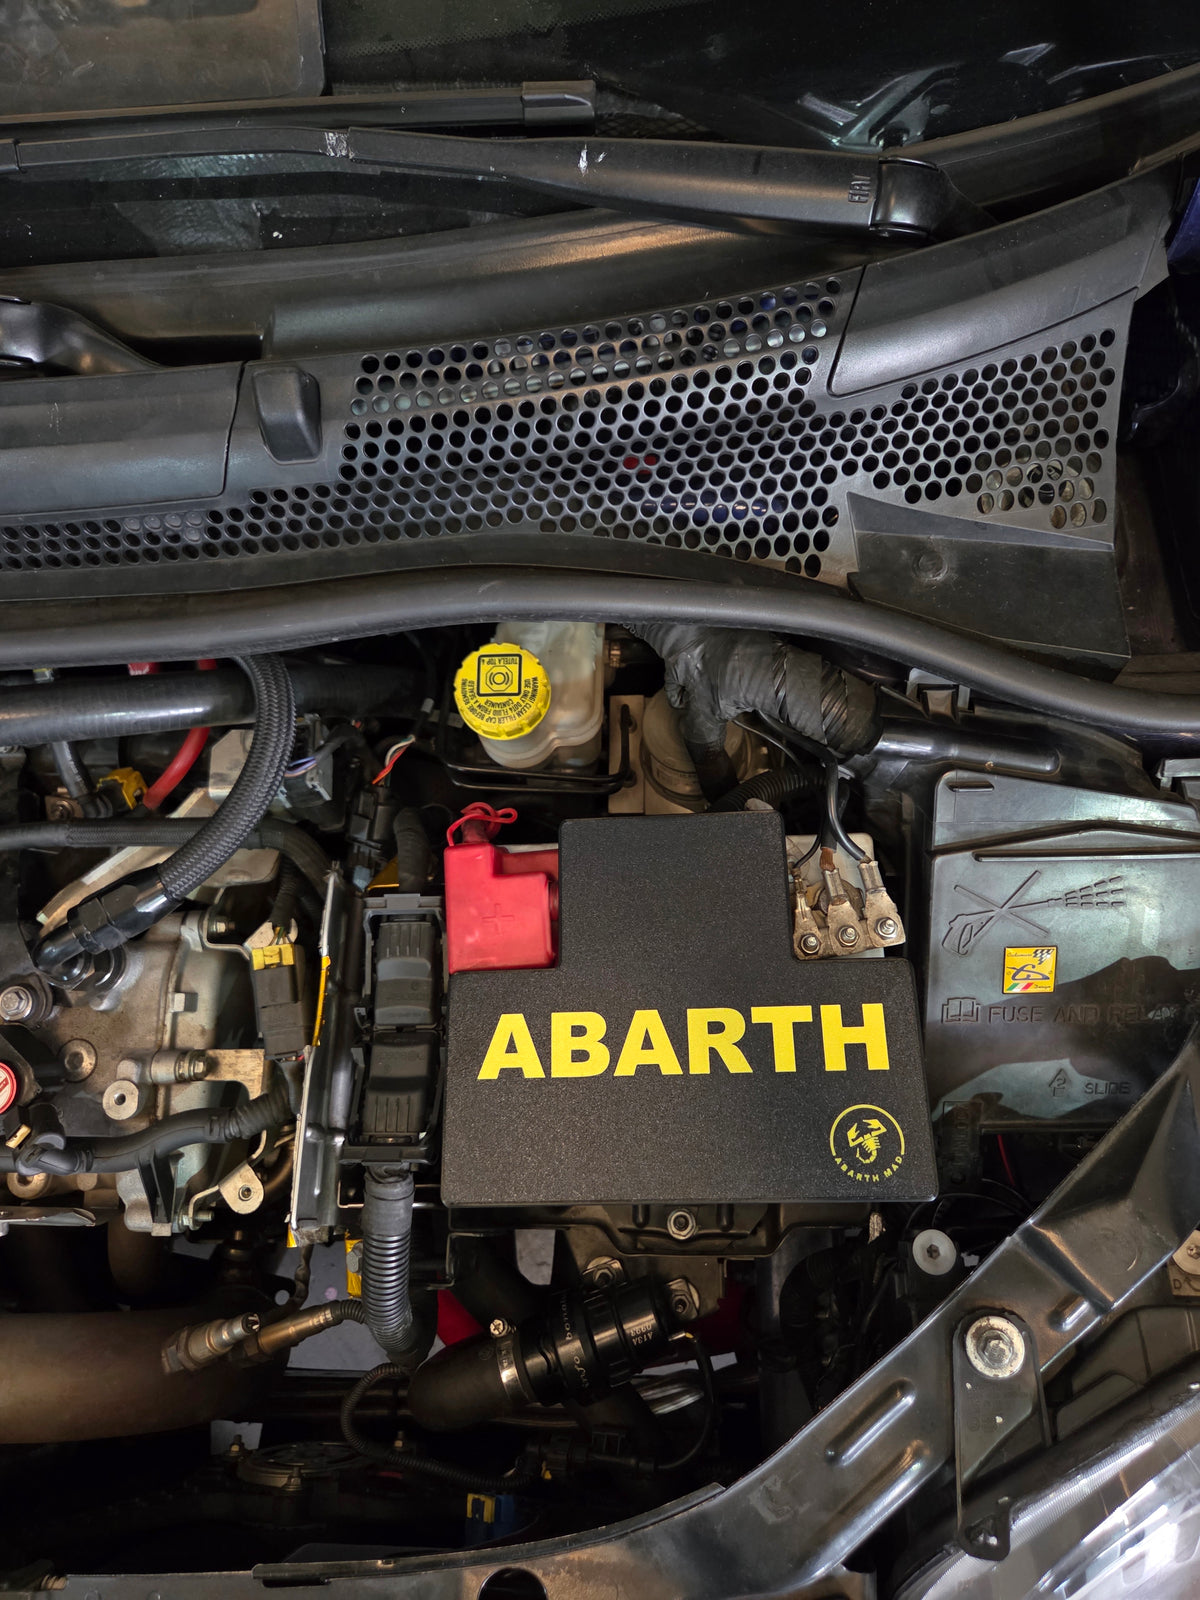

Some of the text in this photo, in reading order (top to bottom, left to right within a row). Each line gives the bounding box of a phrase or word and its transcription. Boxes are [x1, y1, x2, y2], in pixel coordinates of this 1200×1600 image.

[477, 703, 491, 715] FROM
[492, 709, 509, 717] FLUID
[516, 703, 531, 718] CLEAN
[485, 716, 497, 724] CAP
[497, 714, 516, 724] FILLER
[988, 1006, 1043, 1023] FUSE
[1053, 1005, 1098, 1023] AND
[476, 1003, 890, 1080] ABARTH
[1084, 1081, 1132, 1095] SLIDE
[834, 1156, 903, 1182] ABARTH MAD
